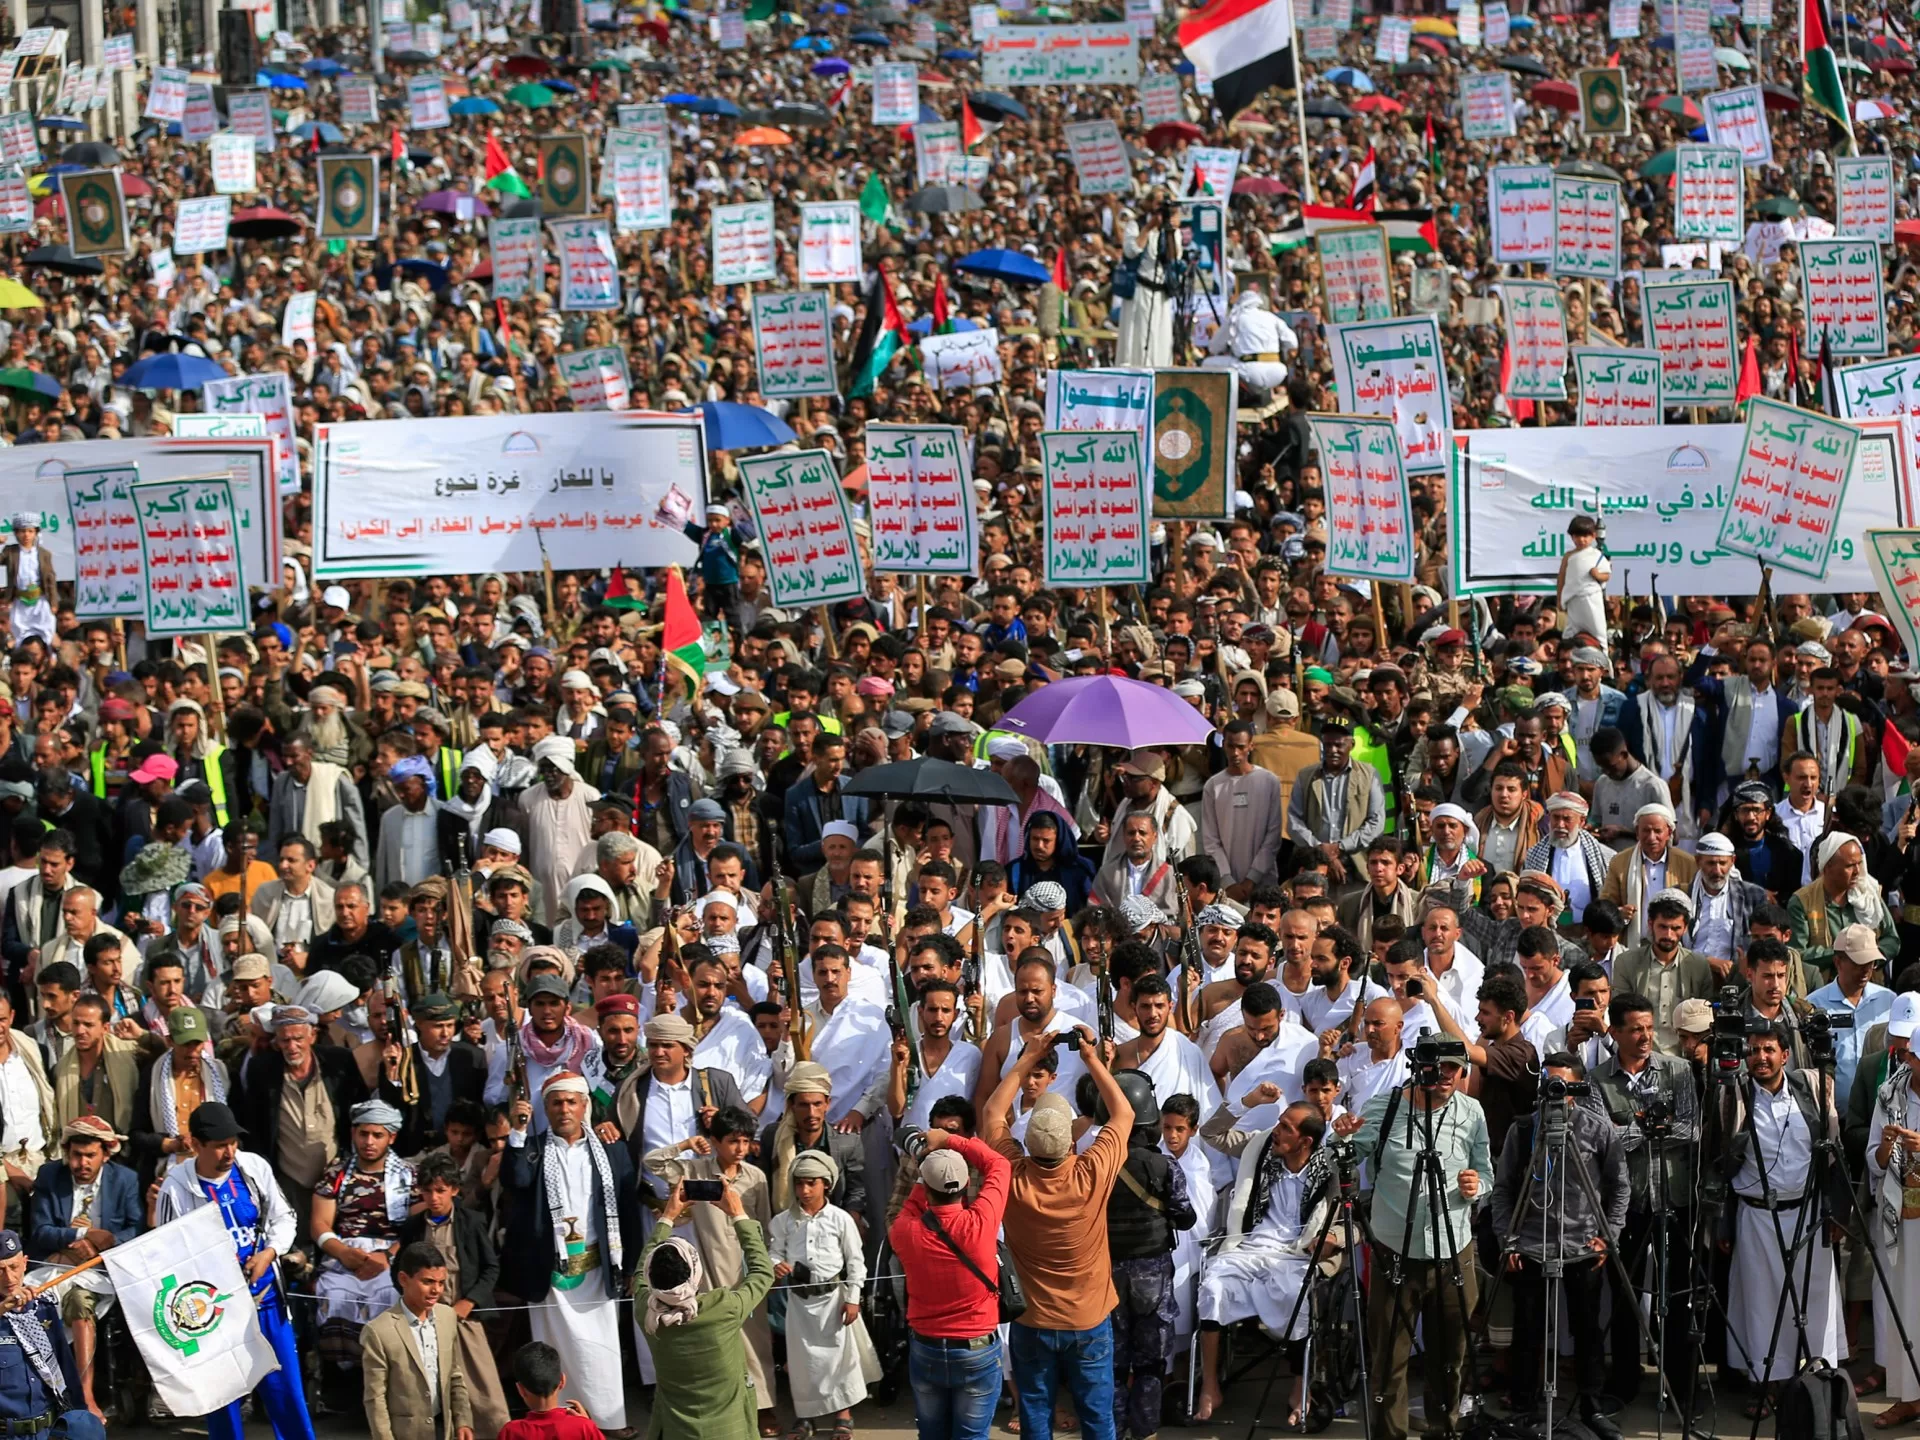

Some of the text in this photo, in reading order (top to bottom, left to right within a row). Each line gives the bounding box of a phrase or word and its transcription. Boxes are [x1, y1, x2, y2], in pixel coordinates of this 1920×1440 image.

[1348, 332, 1433, 369] قاطعوا
[1585, 360, 1656, 388] الله أكبر
[1662, 357, 1685, 373] اليهو
[1063, 380, 1146, 410] قاطعوا
[1851, 366, 1907, 406] أكبر
[1621, 395, 1655, 410] الموت
[867, 433, 954, 465] الله أكبر
[1753, 419, 1850, 458] الله أكبر
[1050, 436, 1134, 471] الله أكبر
[1749, 440, 1798, 471] لأمريكا
[434, 467, 614, 497] يا للعار غزة تجوع
[754, 461, 829, 497] الله أكبر
[919, 467, 958, 486] الموت
[1099, 471, 1136, 492] الموت
[1743, 467, 1791, 501] لإسرائيل
[1800, 461, 1844, 484] الموت
[143, 485, 189, 521] أكبر
[195, 488, 227, 511] الله
[802, 489, 837, 512] الموت
[922, 492, 961, 511] الموت
[1101, 498, 1138, 518] الموت
[1530, 484, 1574, 509] الله
[1582, 486, 1648, 515] سبيل
[1656, 483, 1694, 523] في
[1734, 495, 1771, 517] اليهود
[1794, 488, 1837, 510] الموت
[396, 518, 423, 539] إلى
[429, 514, 473, 534] الغذاء
[479, 515, 522, 536] ترسل
[602, 511, 642, 530] عربية
[809, 514, 844, 536] الموت
[875, 515, 964, 535] اللعنة على اليهود
[1772, 508, 1792, 525] على
[1797, 510, 1831, 535] اللعنة
[193, 520, 231, 541] الموت
[1054, 523, 1140, 544] اللعنة على اليهود
[1521, 525, 1565, 557] الله
[1724, 518, 1776, 553] للإسلام
[196, 546, 234, 566] الموت
[771, 539, 850, 567] اللعنة على اليهود
[875, 537, 965, 566] النصر للإسلام
[1054, 545, 1141, 575] النصر للإسلام
[1776, 537, 1824, 564] النصر
[152, 571, 237, 593] اللعنة على اليهود
[776, 561, 855, 597] النصر للإسلام
[202, 593, 240, 623] النصر
